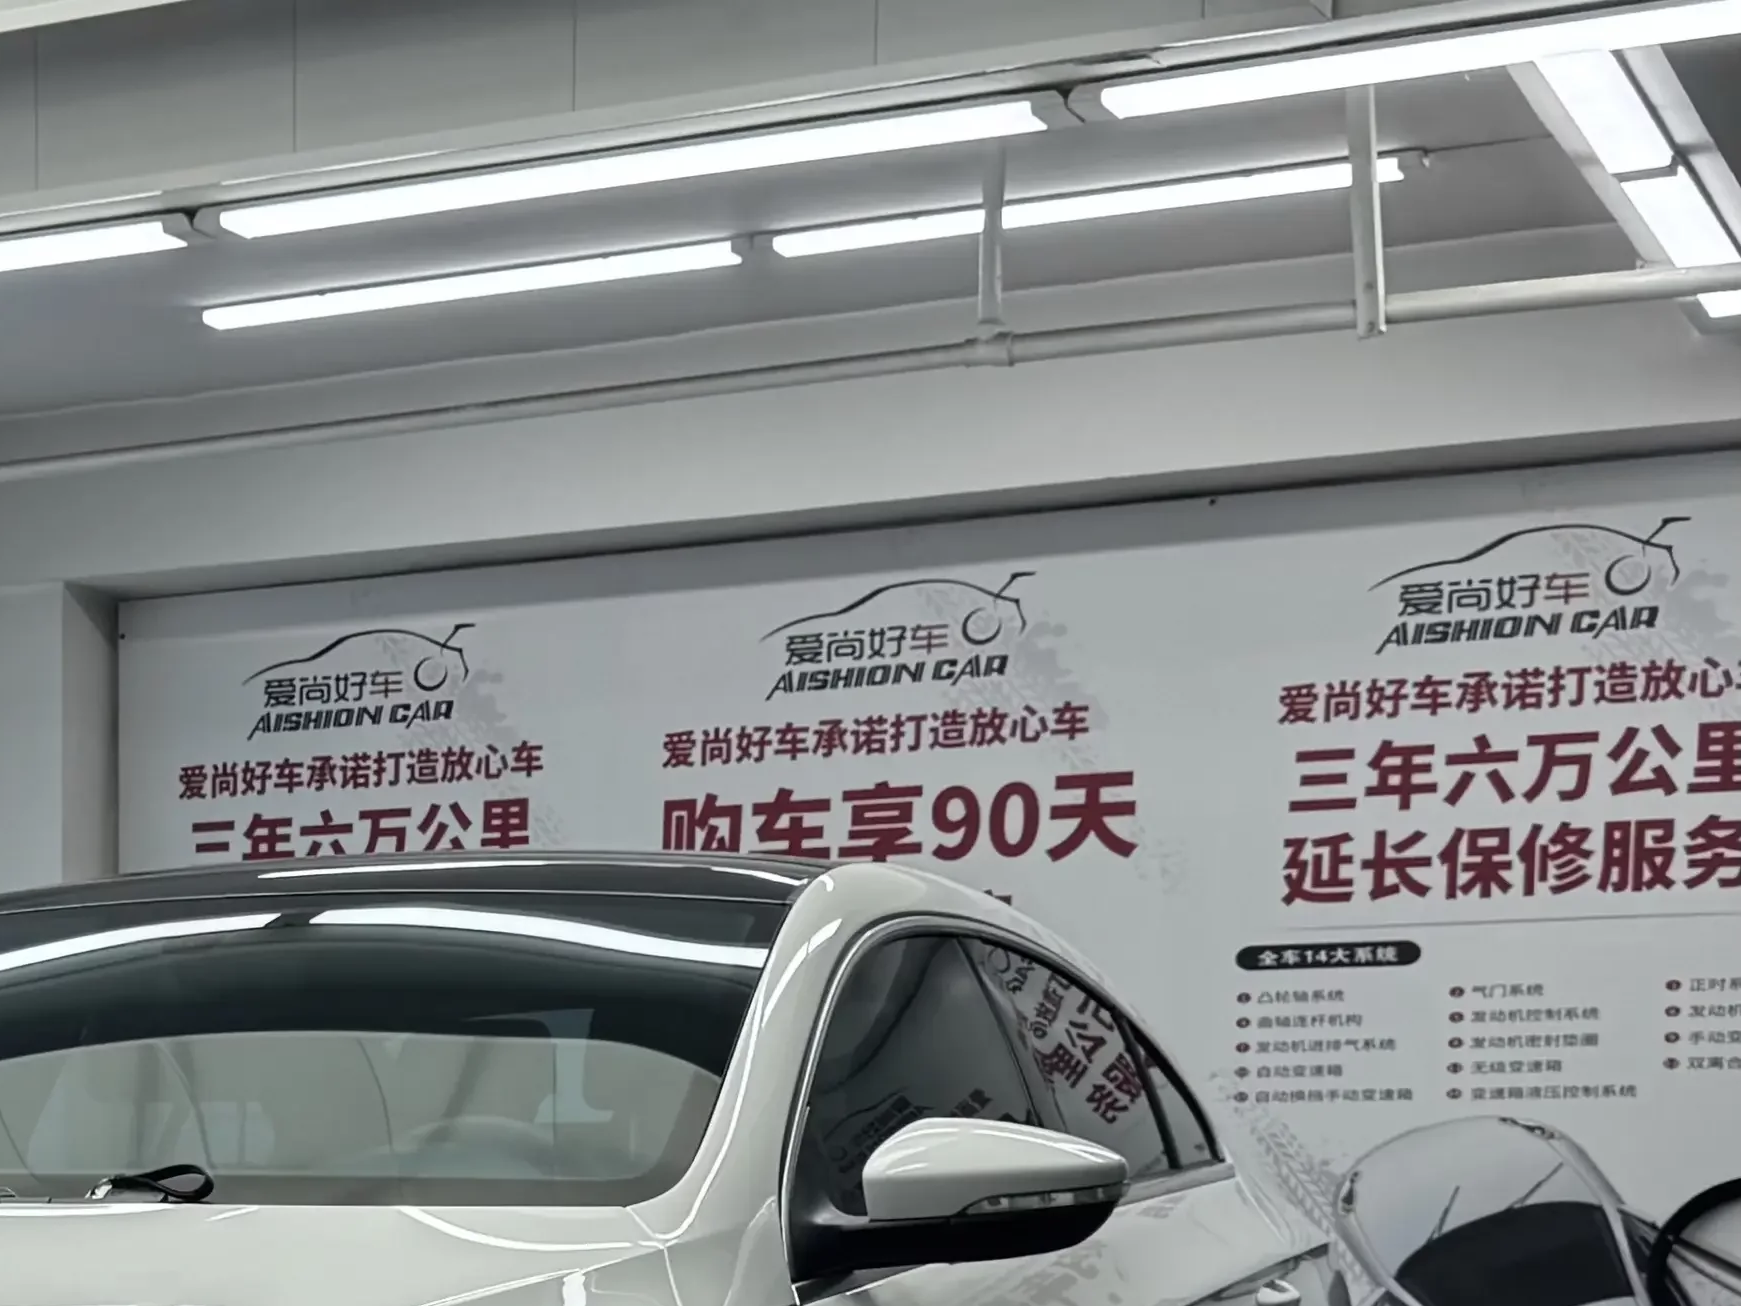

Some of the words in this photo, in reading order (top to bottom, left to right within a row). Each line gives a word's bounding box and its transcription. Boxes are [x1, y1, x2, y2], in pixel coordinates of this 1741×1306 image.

[1398, 572, 1590, 617] 爱尚好车
[784, 623, 950, 666] 爱尚好车
[1375, 613, 1563, 655] AISHION
[1571, 605, 1659, 639] CAR
[263, 669, 403, 709] 爱尚好车
[765, 662, 925, 701] AISHION
[932, 653, 1009, 686] CAR
[1278, 657, 1741, 725] 爱尚好车承诺打造放心
[247, 704, 383, 741] AISHION
[388, 699, 454, 729] CAR
[662, 701, 1090, 769] 爱尚好车承诺打造放心车
[178, 740, 544, 800] 爱尚好车承诺打造放心车
[1288, 721, 1741, 813] 三年六万公里
[661, 771, 1138, 864] 购车享90天
[1282, 814, 1741, 906] 延长保修服务
[1258, 946, 1400, 967] 全车14大系统
